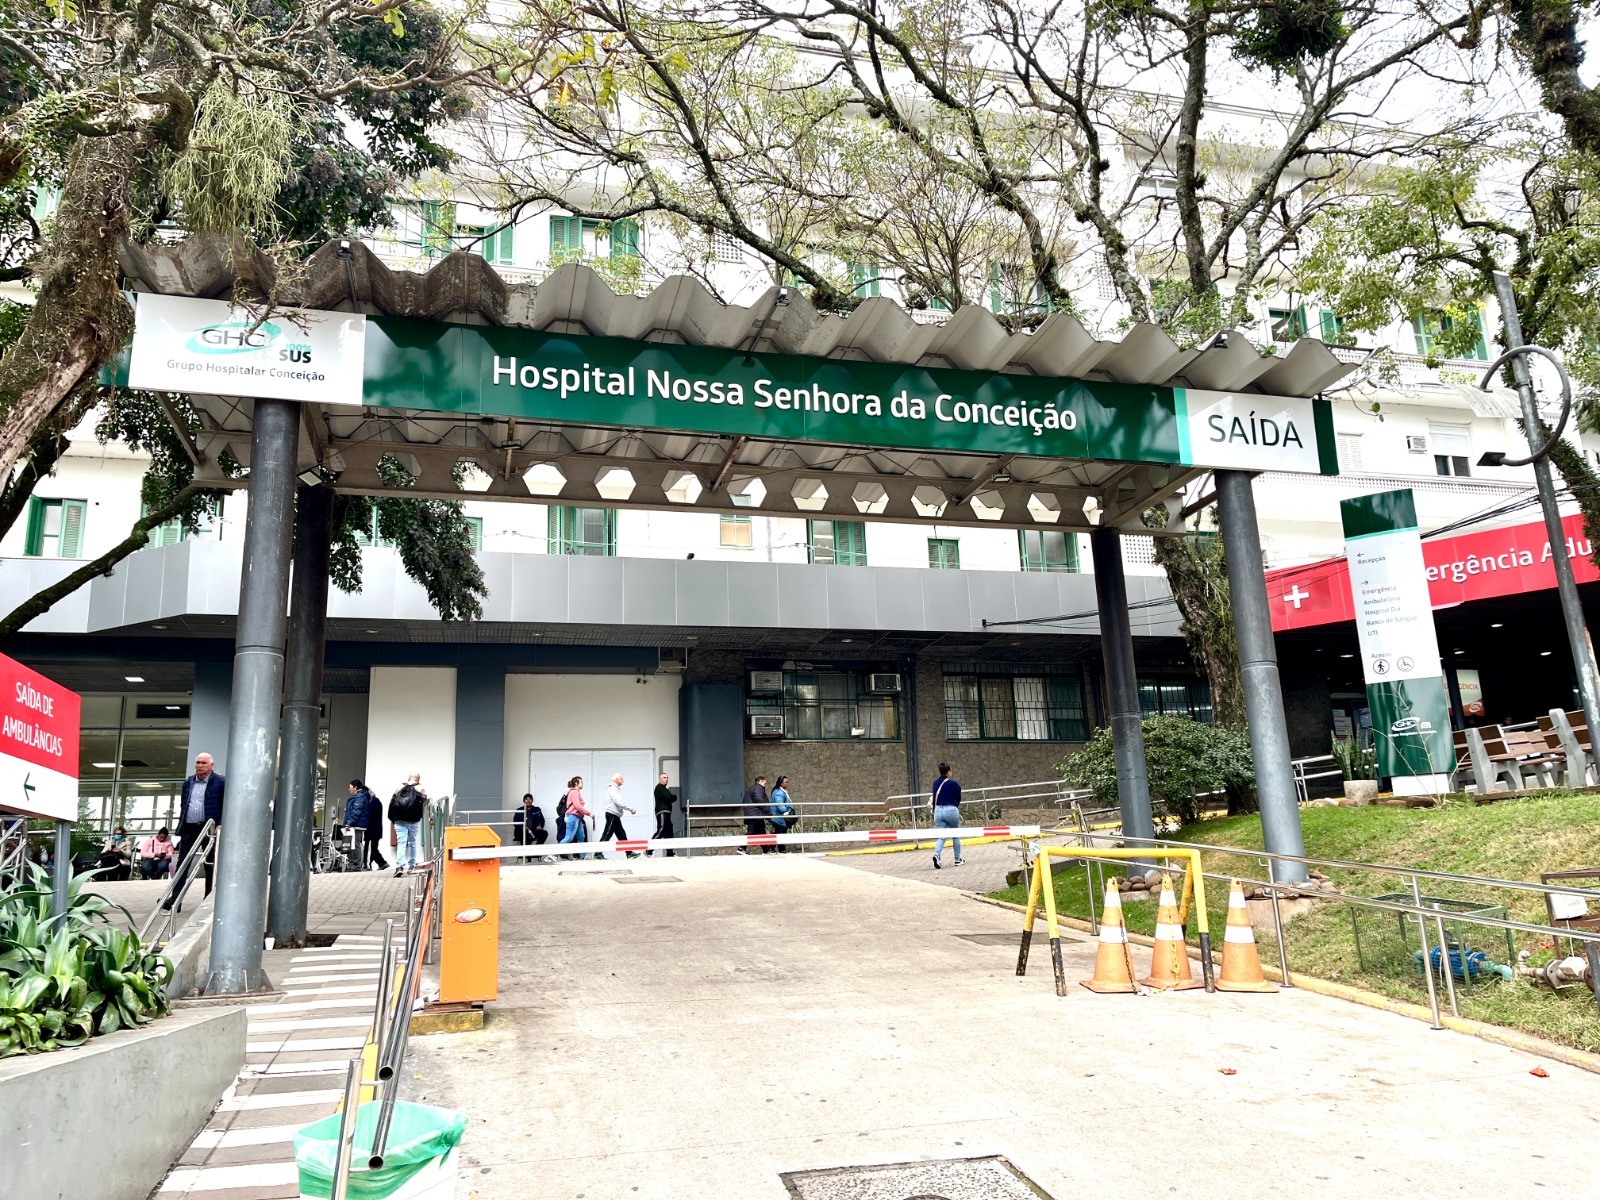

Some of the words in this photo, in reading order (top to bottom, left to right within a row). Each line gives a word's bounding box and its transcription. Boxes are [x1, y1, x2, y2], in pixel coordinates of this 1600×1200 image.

[201, 328, 265, 347] GHC
[279, 349, 312, 364] SUS
[166, 359, 203, 371] Grupo
[206, 363, 266, 377] Hospitalar
[269, 368, 326, 383] Conceição
[492, 355, 635, 399] Hospital
[647, 369, 744, 405] Nossa
[753, 379, 882, 417] Senhora
[890, 390, 926, 419] da
[934, 394, 1078, 436] Conceição
[1208, 410, 1304, 449] SAÍDA
[1358, 556, 1386, 565] Recepção
[1426, 547, 1533, 583] ergência
[1362, 586, 1397, 596] Emergência
[1365, 608, 1389, 616] Hospital
[1366, 619, 1385, 627] Banco
[1394, 615, 1418, 624] Sangue
[1368, 629, 1379, 637] UTI
[16, 682, 42, 712] SAÍDA
[43, 695, 54, 717] DE
[2, 715, 63, 757] AMBULÂNCIAS
